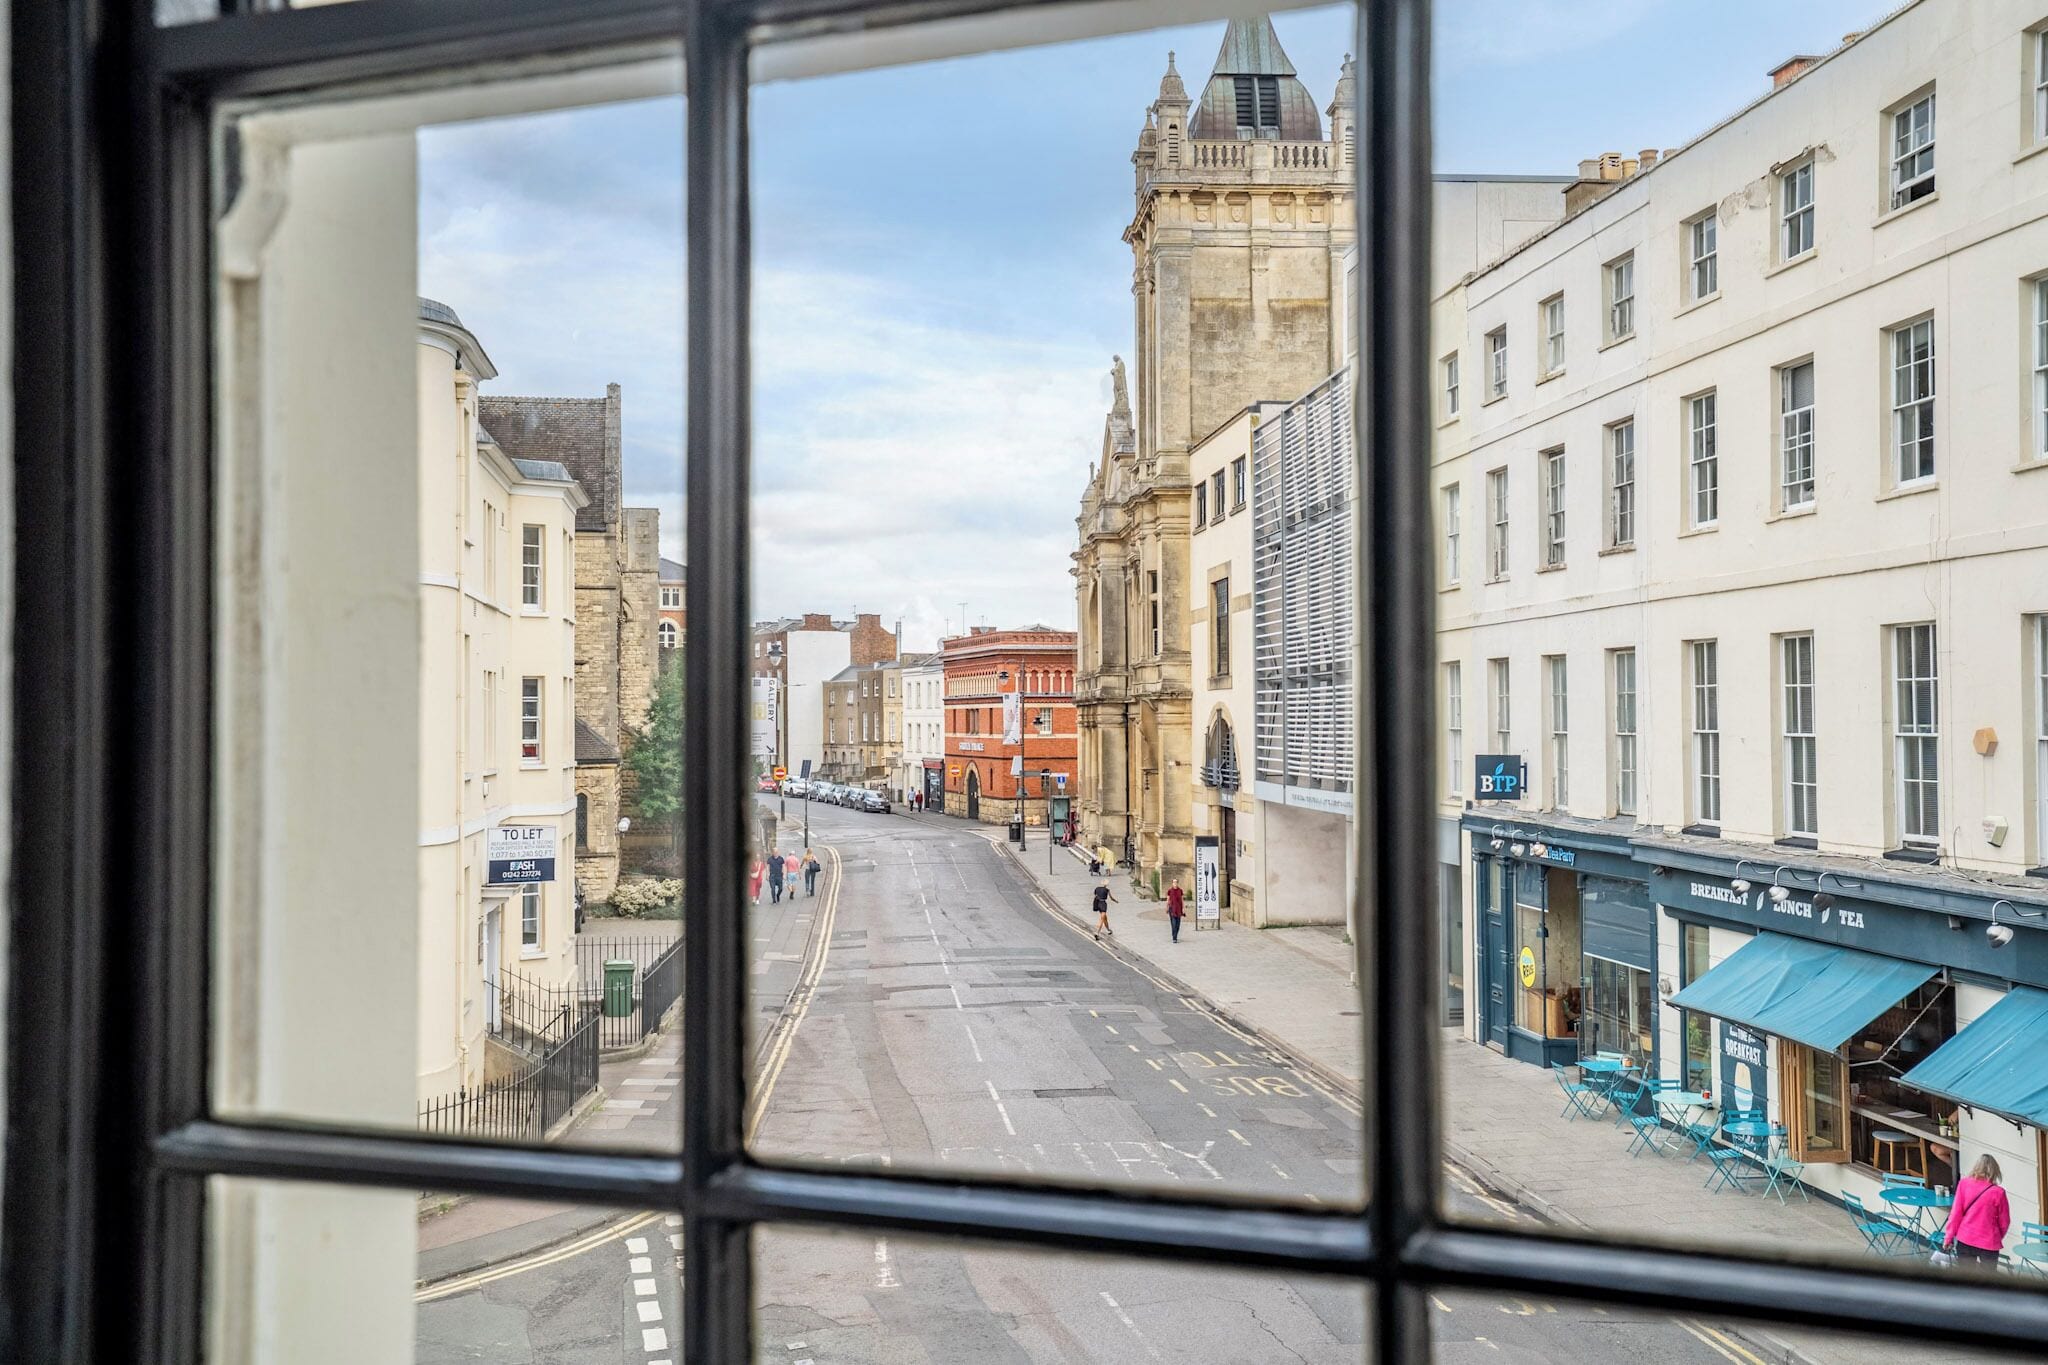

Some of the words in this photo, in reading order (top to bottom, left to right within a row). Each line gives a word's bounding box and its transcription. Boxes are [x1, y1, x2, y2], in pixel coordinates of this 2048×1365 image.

[767, 679, 775, 722] GALLERY
[1480, 774, 1518, 793] BTP
[502, 829, 519, 840] TO
[522, 828, 544, 840] LET
[1838, 909, 1865, 929] TEA
[1725, 1037, 1761, 1066] BREAKFAST
[1198, 1076, 1310, 1098] BUS
